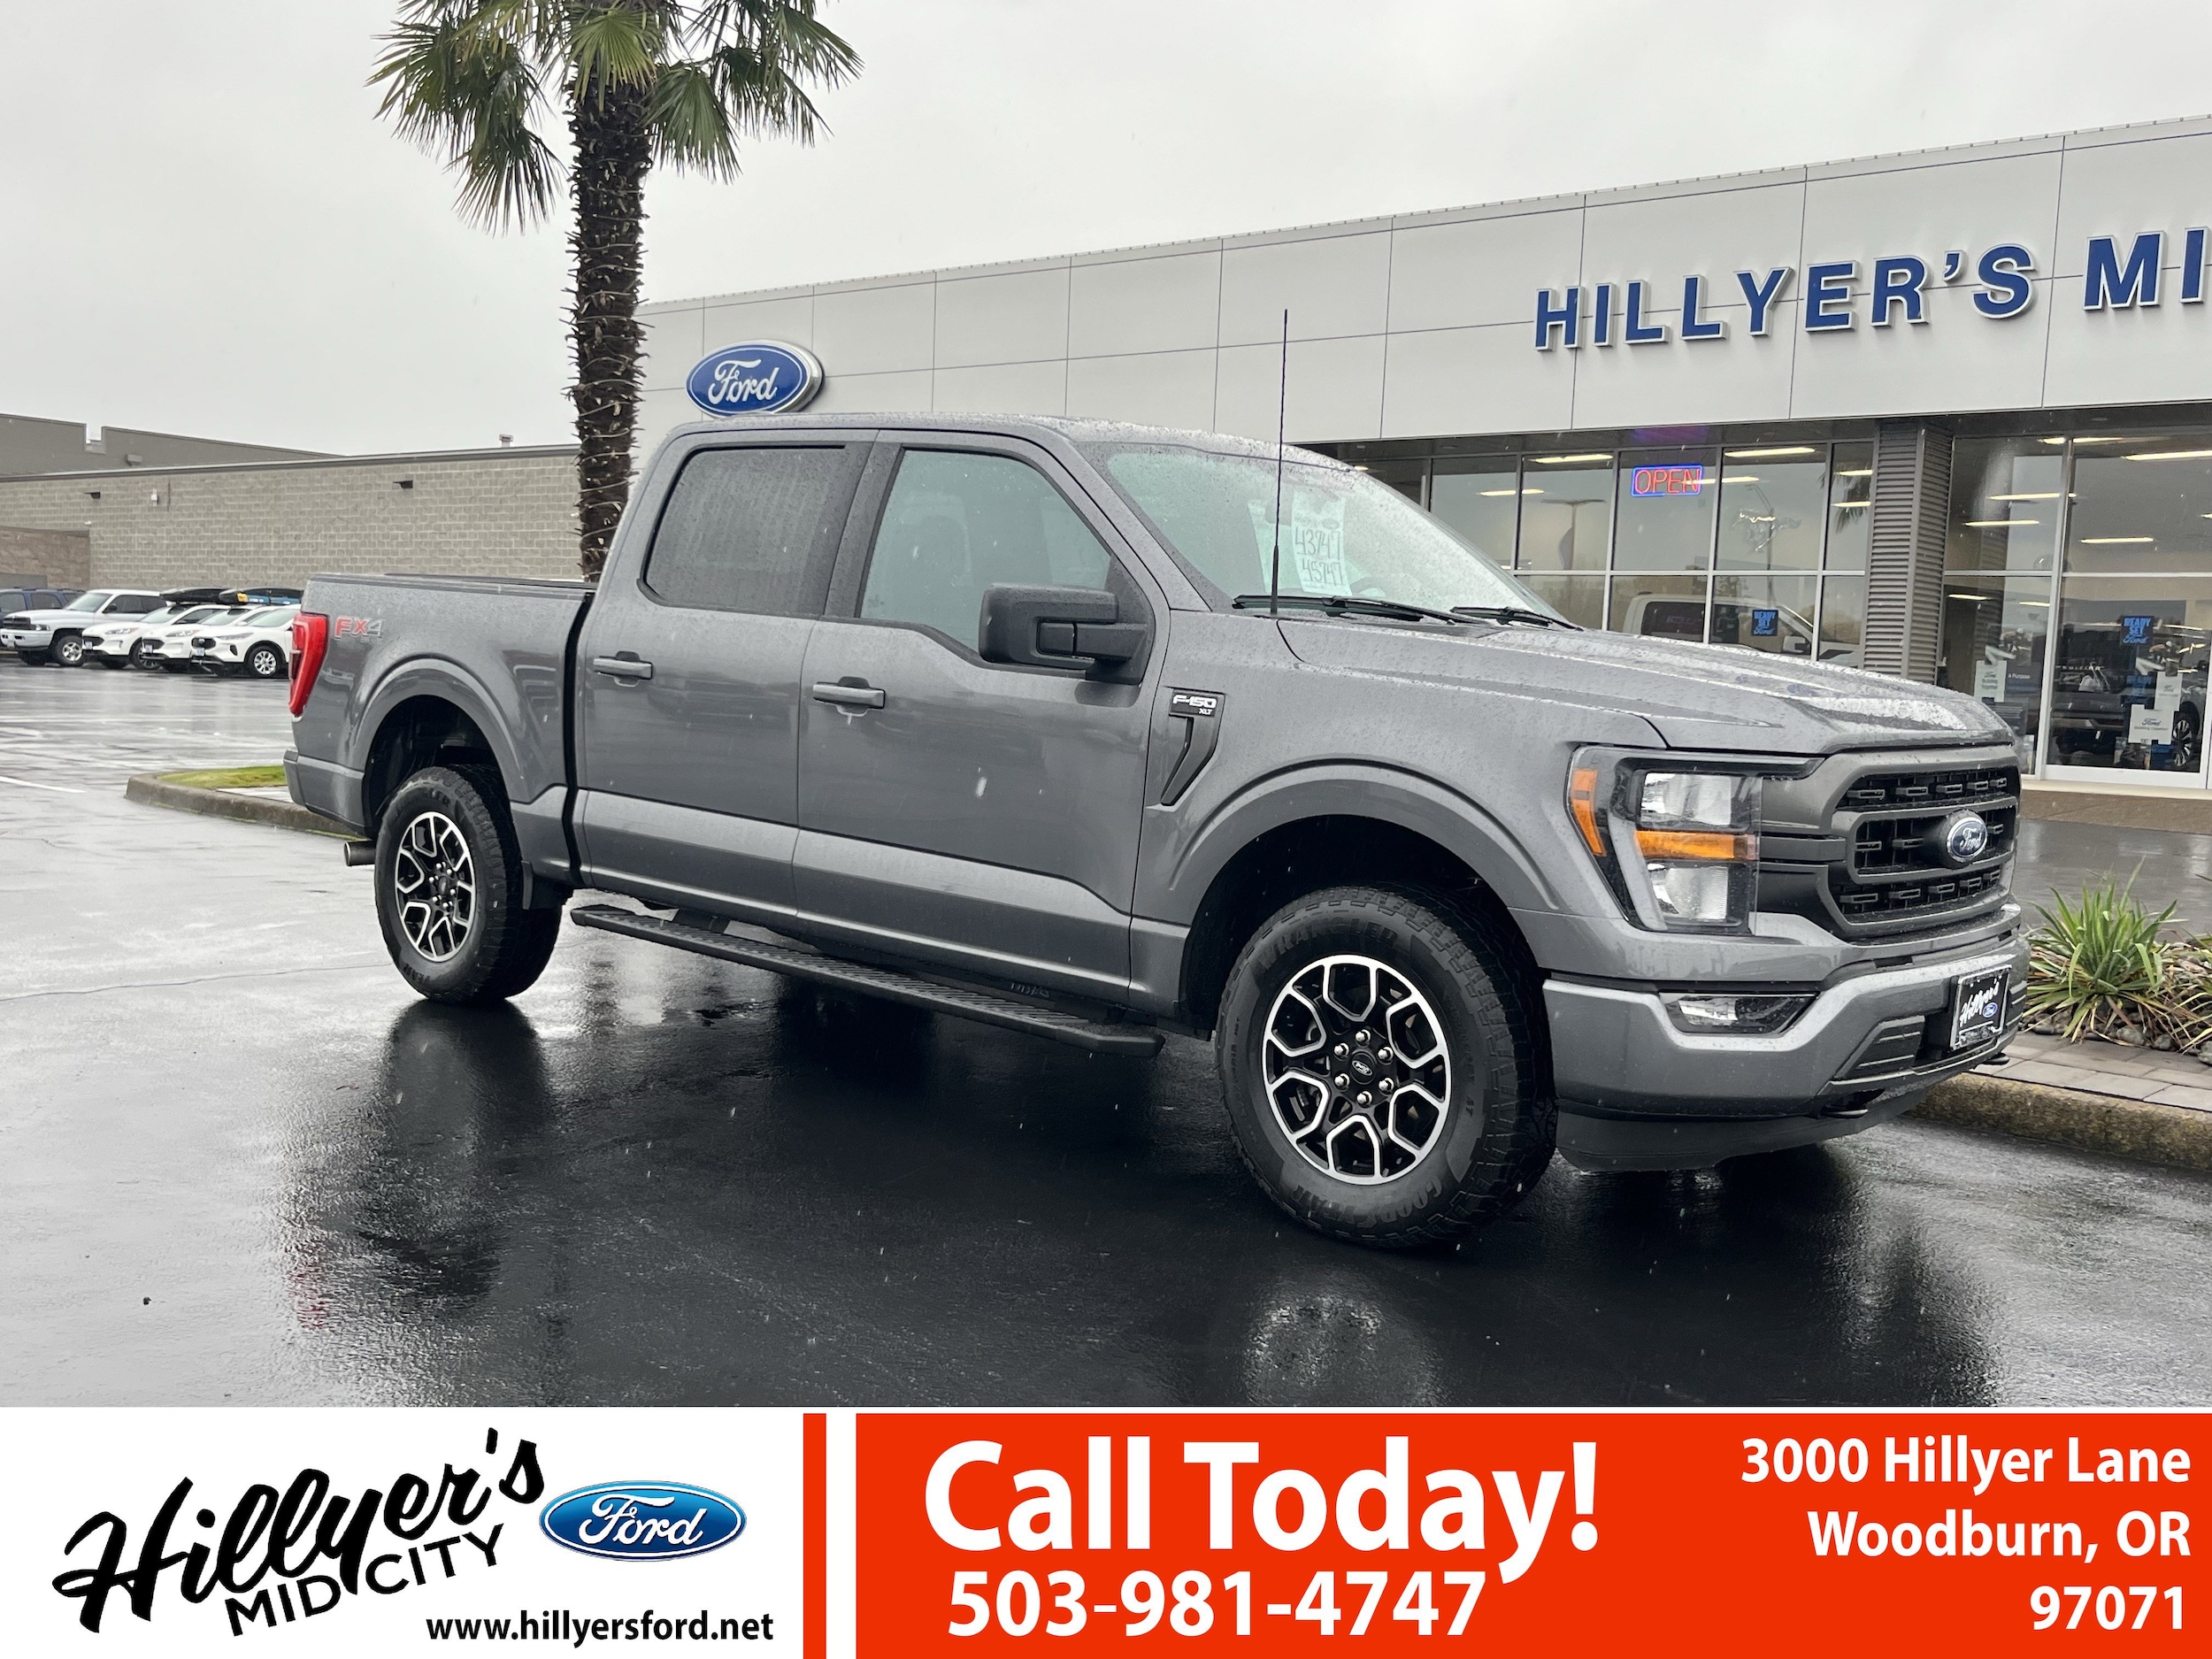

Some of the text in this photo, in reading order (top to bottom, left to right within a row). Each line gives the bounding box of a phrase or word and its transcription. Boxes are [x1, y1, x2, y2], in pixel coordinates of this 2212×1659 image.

[1533, 242, 2037, 351] HILLYER'S
[708, 359, 780, 404] Ford
[1634, 468, 1700, 494] OPEN
[1294, 527, 1341, 560] 43747
[1302, 559, 1343, 585] 45747
[334, 617, 382, 638] FX4
[1173, 694, 1217, 709] F-150
[1959, 827, 1982, 850] Ford
